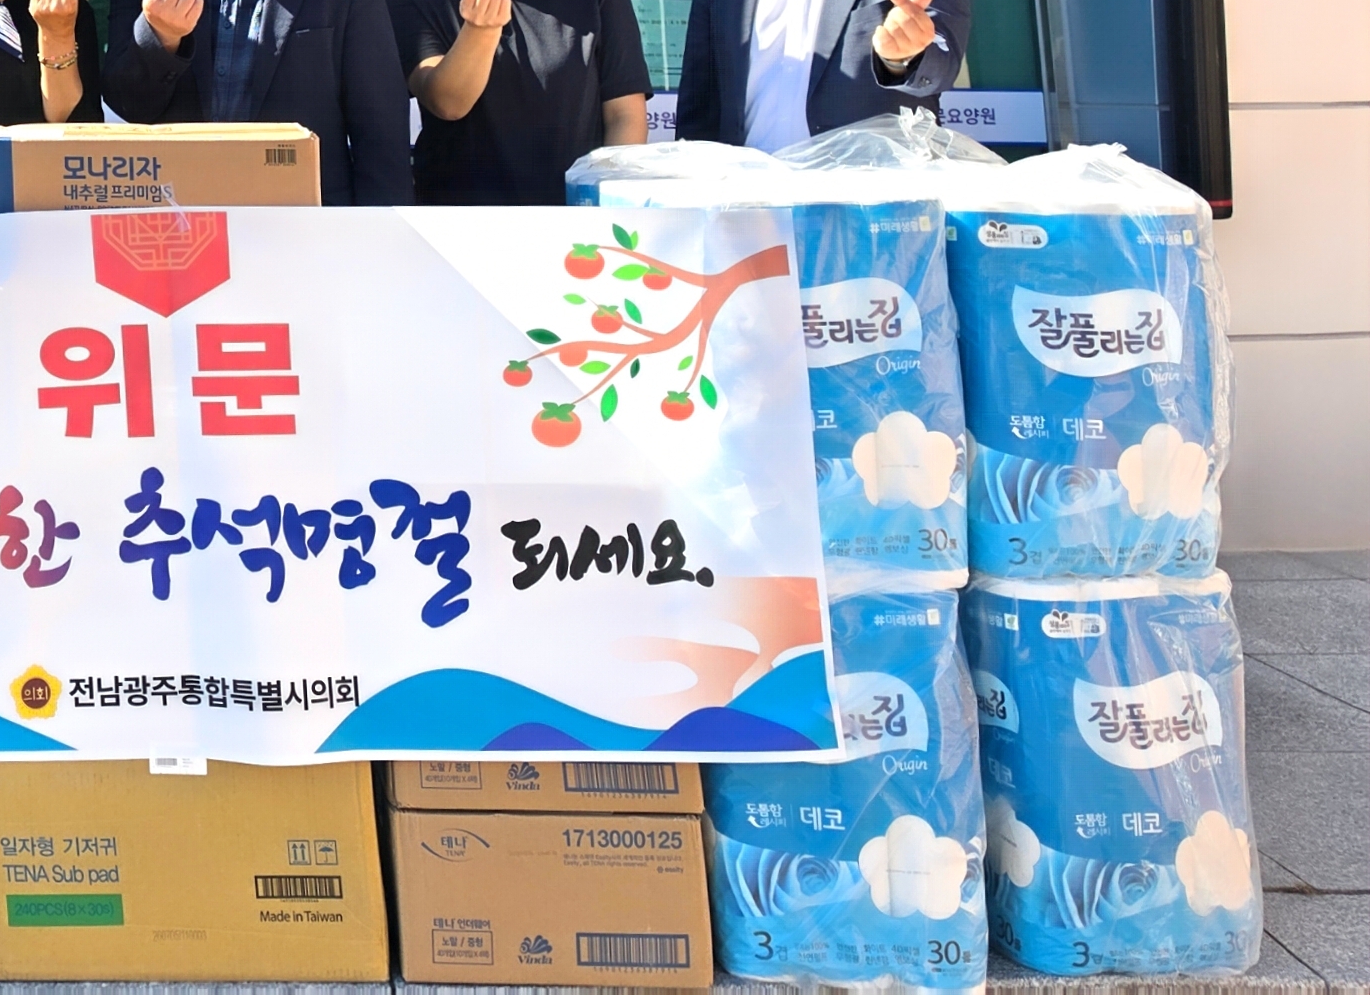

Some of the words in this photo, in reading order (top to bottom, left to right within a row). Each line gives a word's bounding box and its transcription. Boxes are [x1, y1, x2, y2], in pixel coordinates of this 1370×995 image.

[63, 155, 162, 181] 모나리자
[64, 184, 109, 203] 내추럴
[1028, 307, 1166, 358] 잘풀리는집
[875, 355, 921, 376] Origin
[812, 409, 838, 431] 코
[1062, 418, 1107, 441] 데코
[500, 517, 715, 591] 되세요.
[23, 686, 49, 702] 의회
[68, 674, 360, 712] 전남광주통합특별시의회
[506, 781, 540, 790] Vinda
[800, 807, 846, 831] 데코
[1122, 813, 1163, 837] 데코
[0, 836, 54, 857] 일자형
[63, 836, 118, 857] 기저귀
[562, 829, 683, 850] 1713000125
[2, 864, 50, 883] TENA
[51, 864, 84, 883] Sub
[88, 865, 120, 885] pad
[259, 910, 291, 922] Made
[292, 910, 303, 922] in
[305, 910, 343, 922] Taiwan
[517, 955, 553, 965] Vinda
